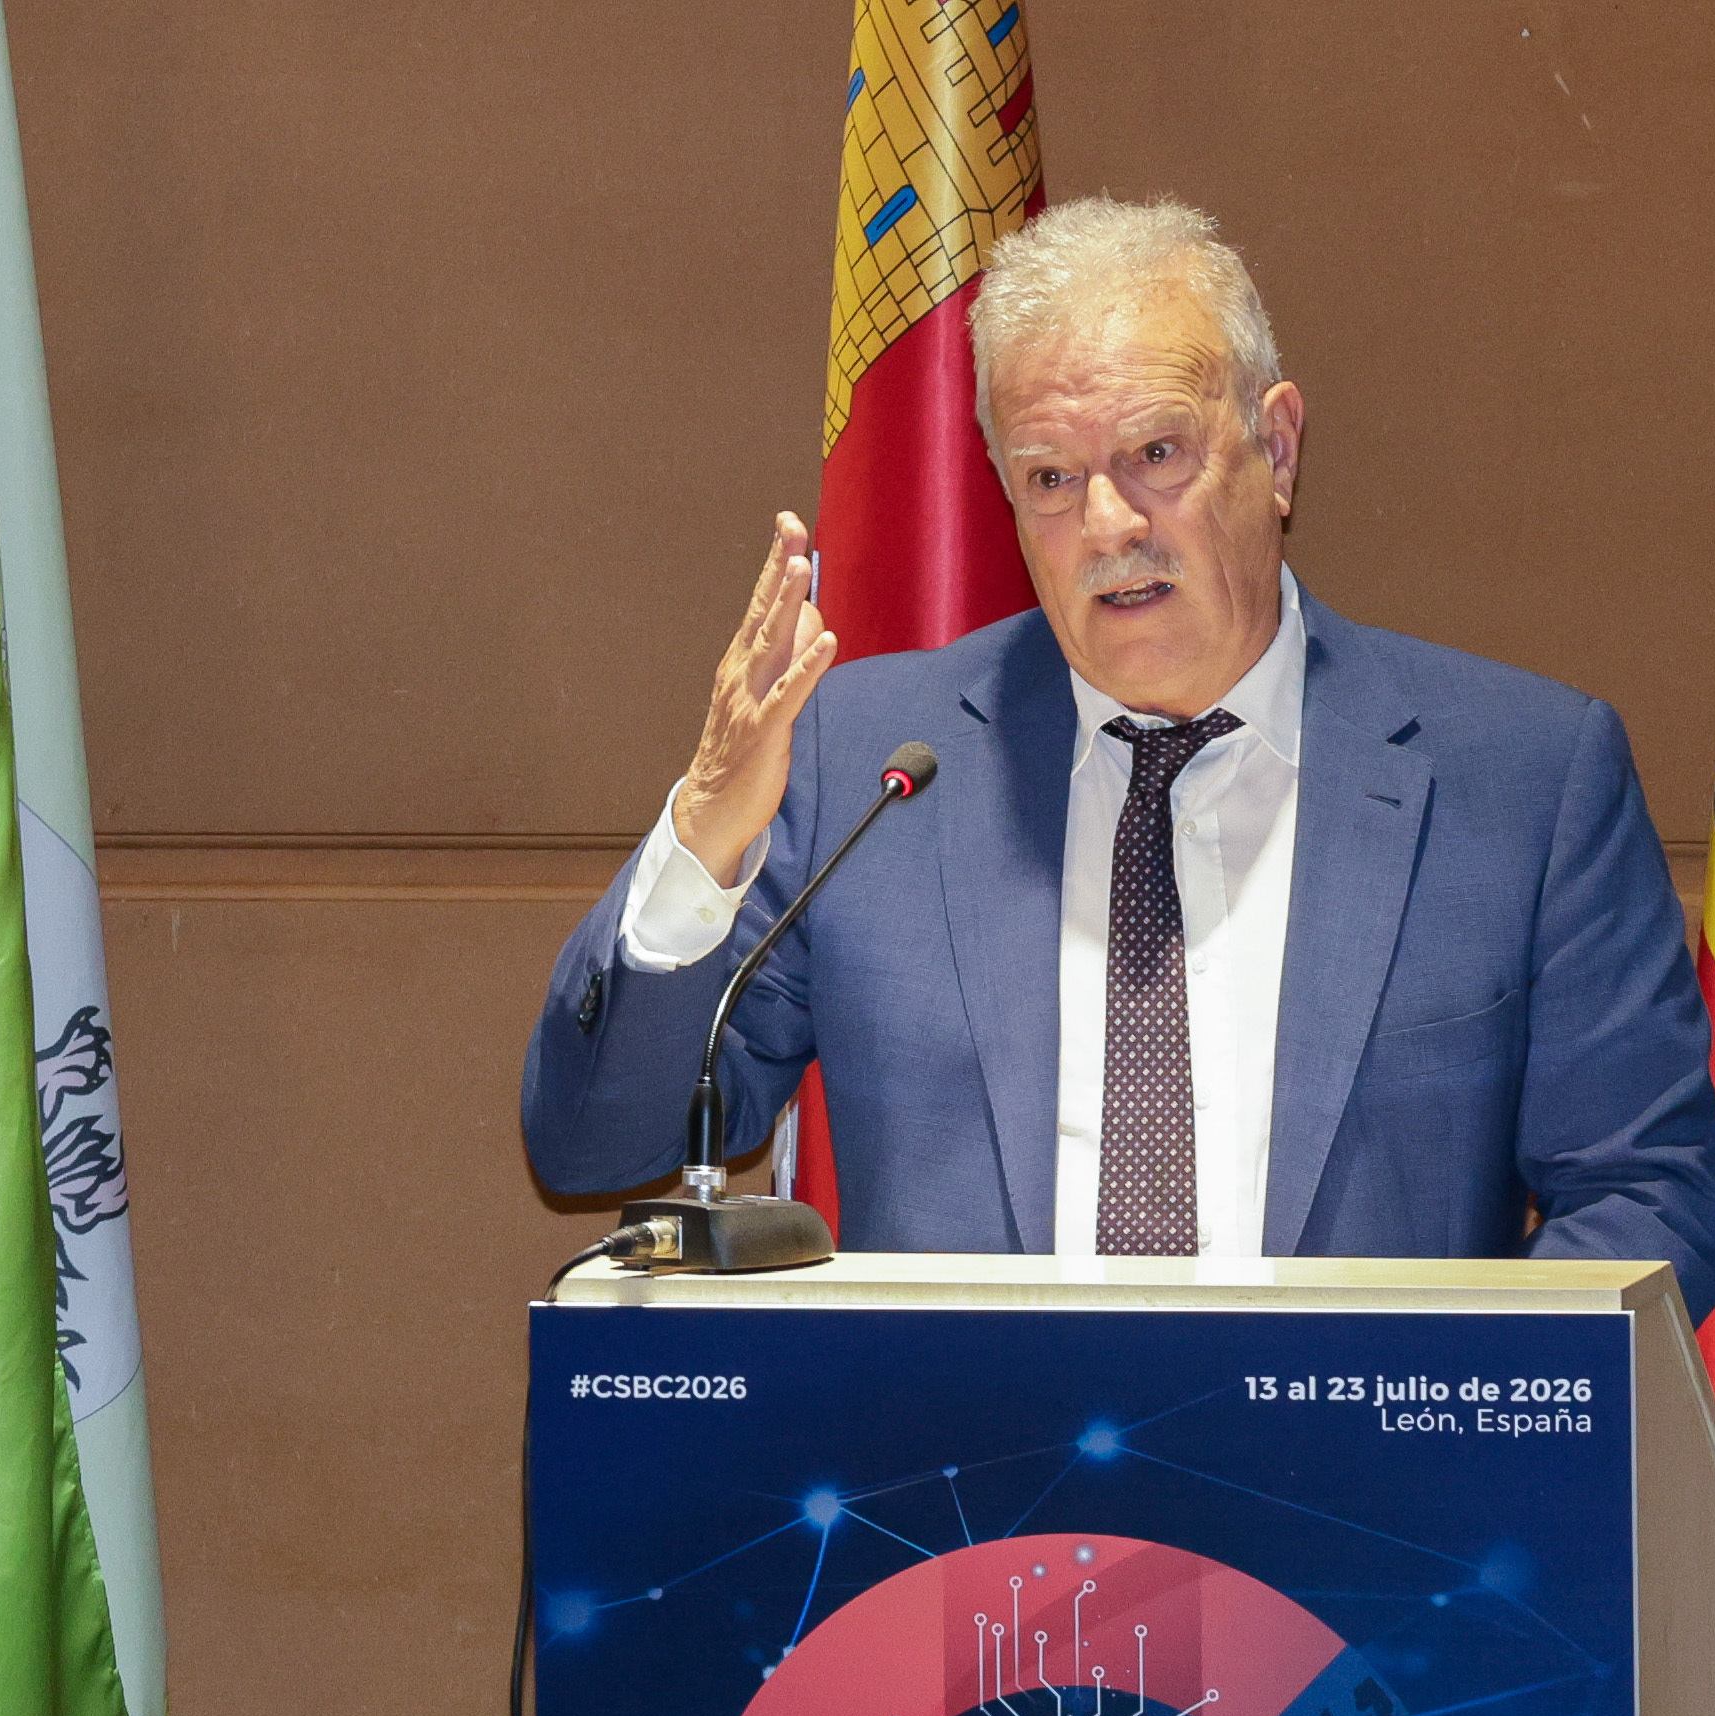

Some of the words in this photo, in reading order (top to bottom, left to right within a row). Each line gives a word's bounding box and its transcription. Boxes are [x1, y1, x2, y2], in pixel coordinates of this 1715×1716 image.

[570, 1374, 747, 1400] #CSBC2026
[1245, 1376, 1278, 1401] 13
[1287, 1375, 1317, 1401] al
[1327, 1376, 1366, 1401] 23
[1373, 1375, 1450, 1407] julio
[1458, 1376, 1501, 1402] de
[1509, 1377, 1593, 1403] 2026
[1381, 1407, 1464, 1435] León,
[1476, 1407, 1592, 1439] España
